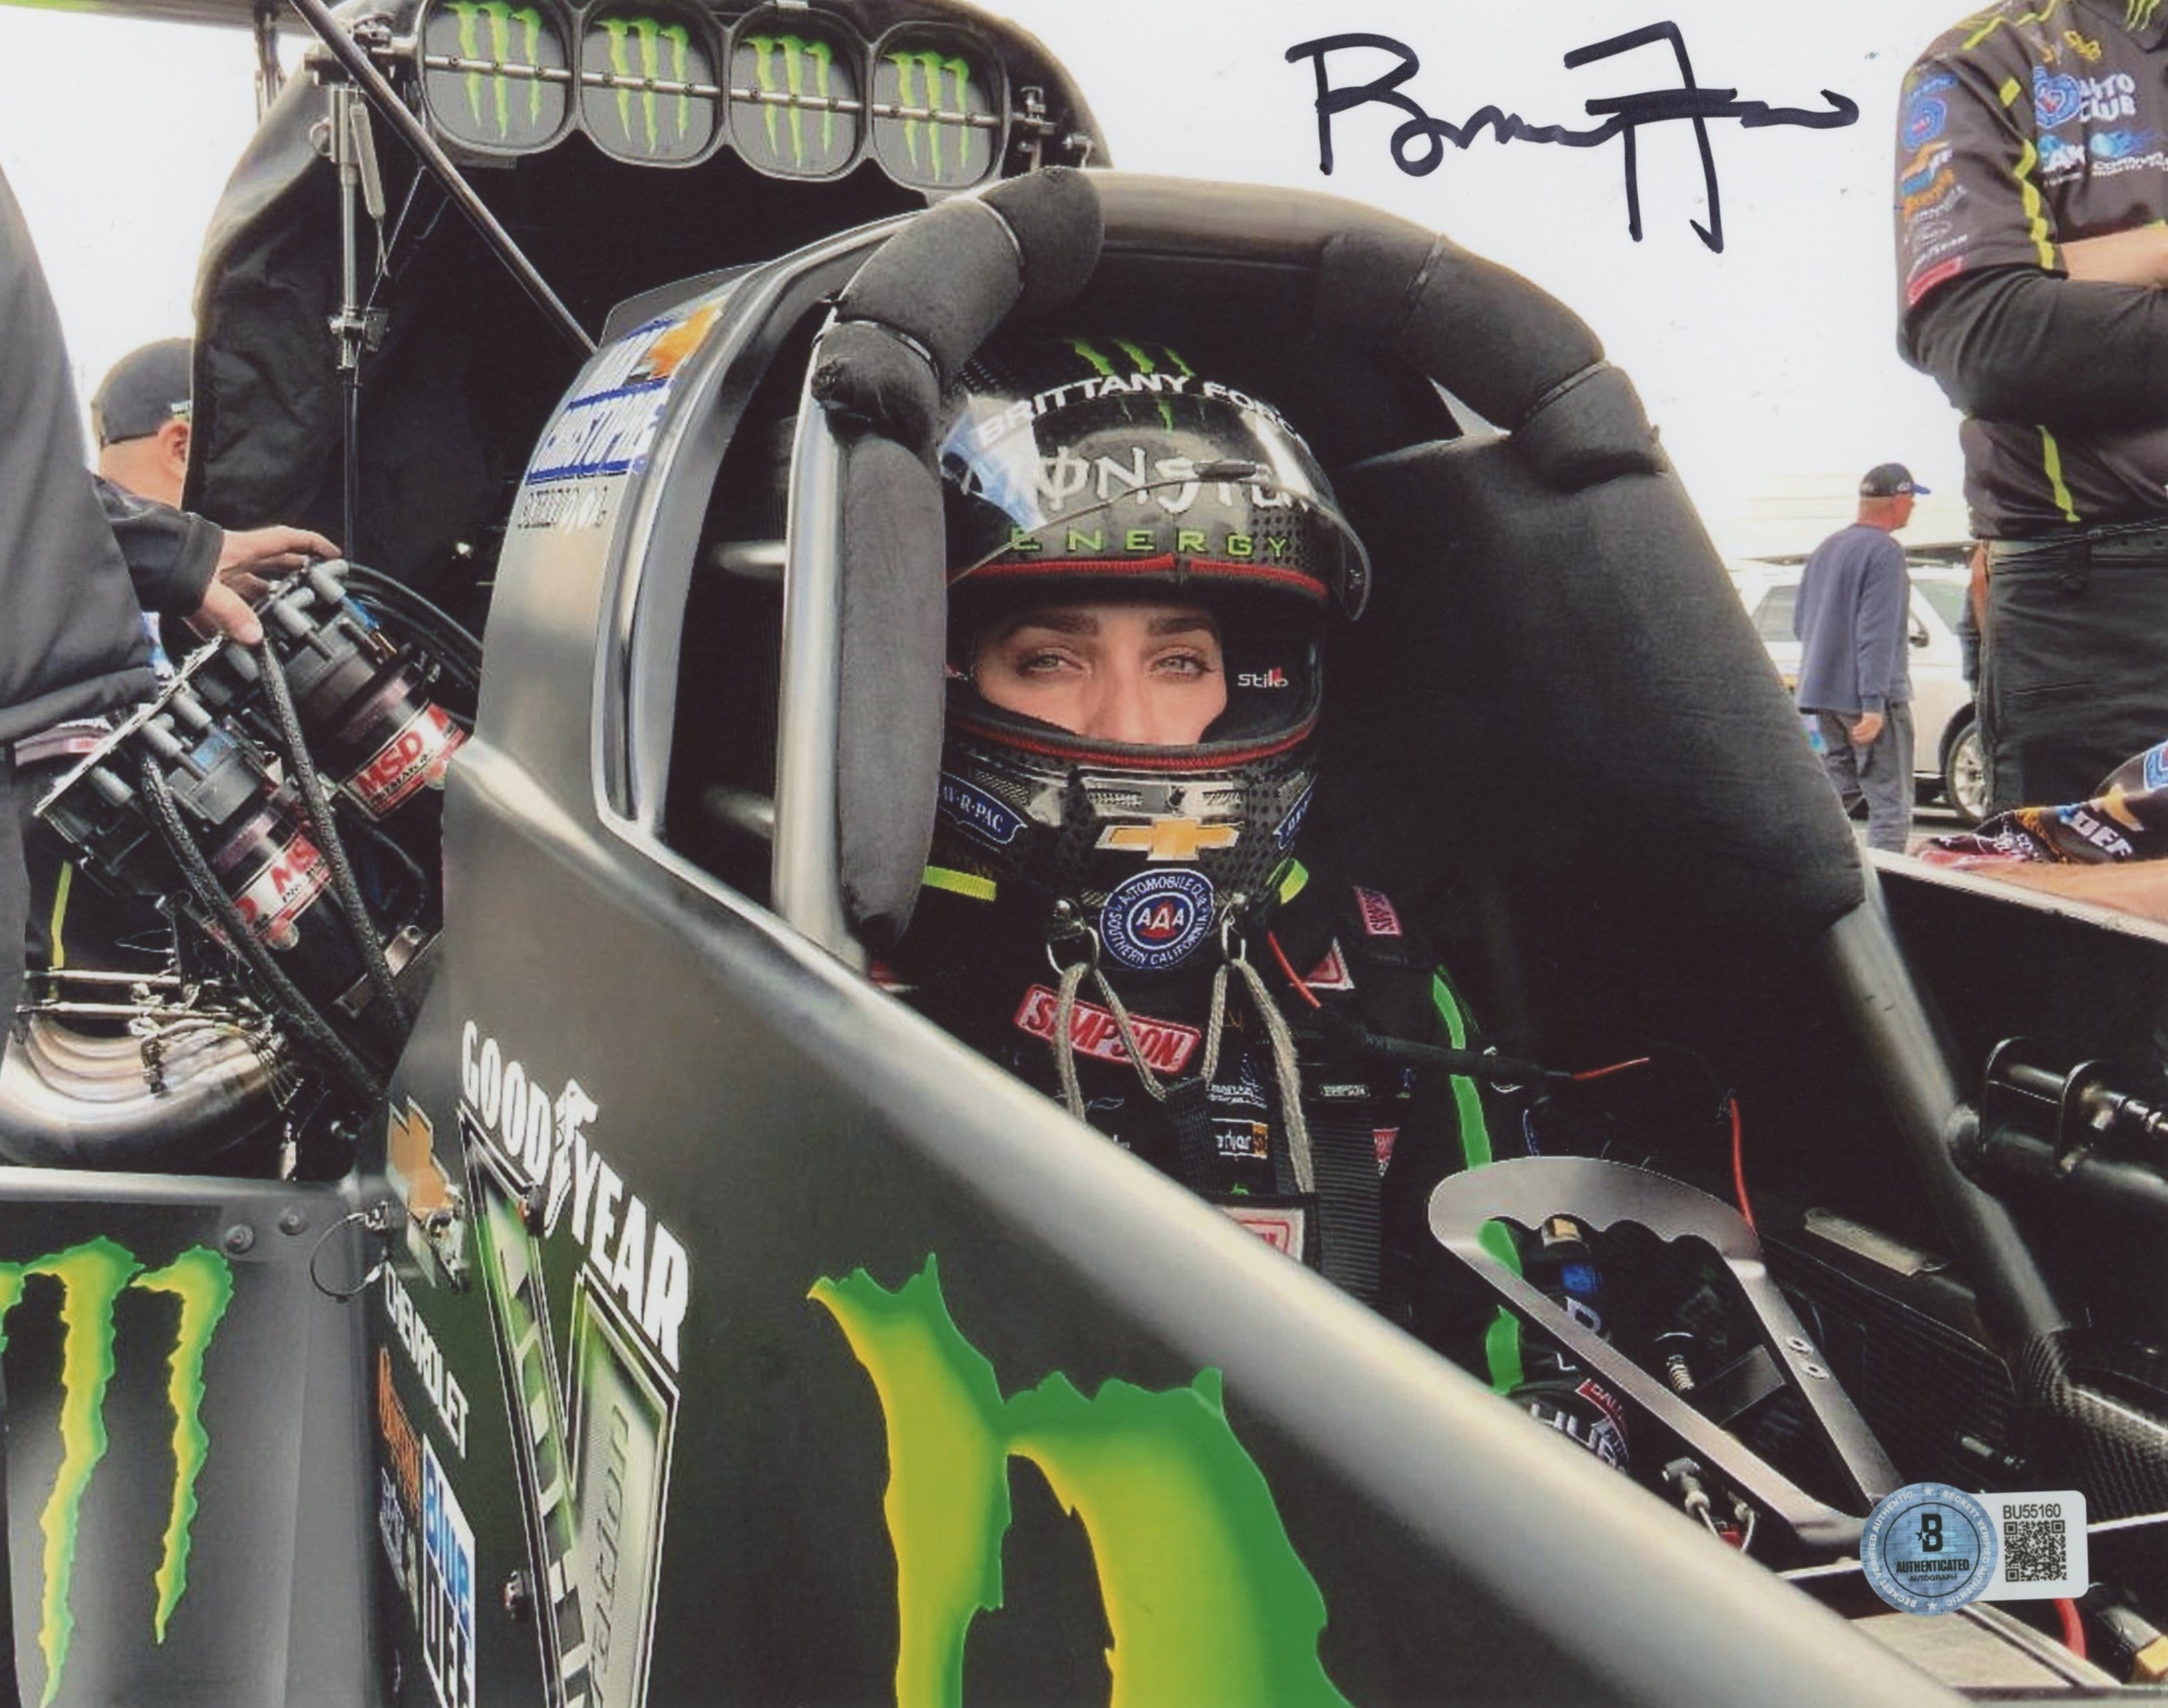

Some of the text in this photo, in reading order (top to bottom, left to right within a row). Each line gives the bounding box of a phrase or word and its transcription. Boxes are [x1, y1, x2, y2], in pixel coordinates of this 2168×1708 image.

[2081, 95, 2136, 122] CLUB
[976, 373, 1189, 445] BRITTANY
[1009, 526, 1288, 558] ENERGY
[356, 730, 423, 799] MSD
[1119, 876, 1194, 906] AUTOMOBILE
[1107, 912, 1208, 965] SOUTHERN CALIFORNIA
[1135, 907, 1186, 931] AAA
[1027, 997, 1185, 1067] SMPSON
[462, 1020, 689, 1373] GOODYEAR
